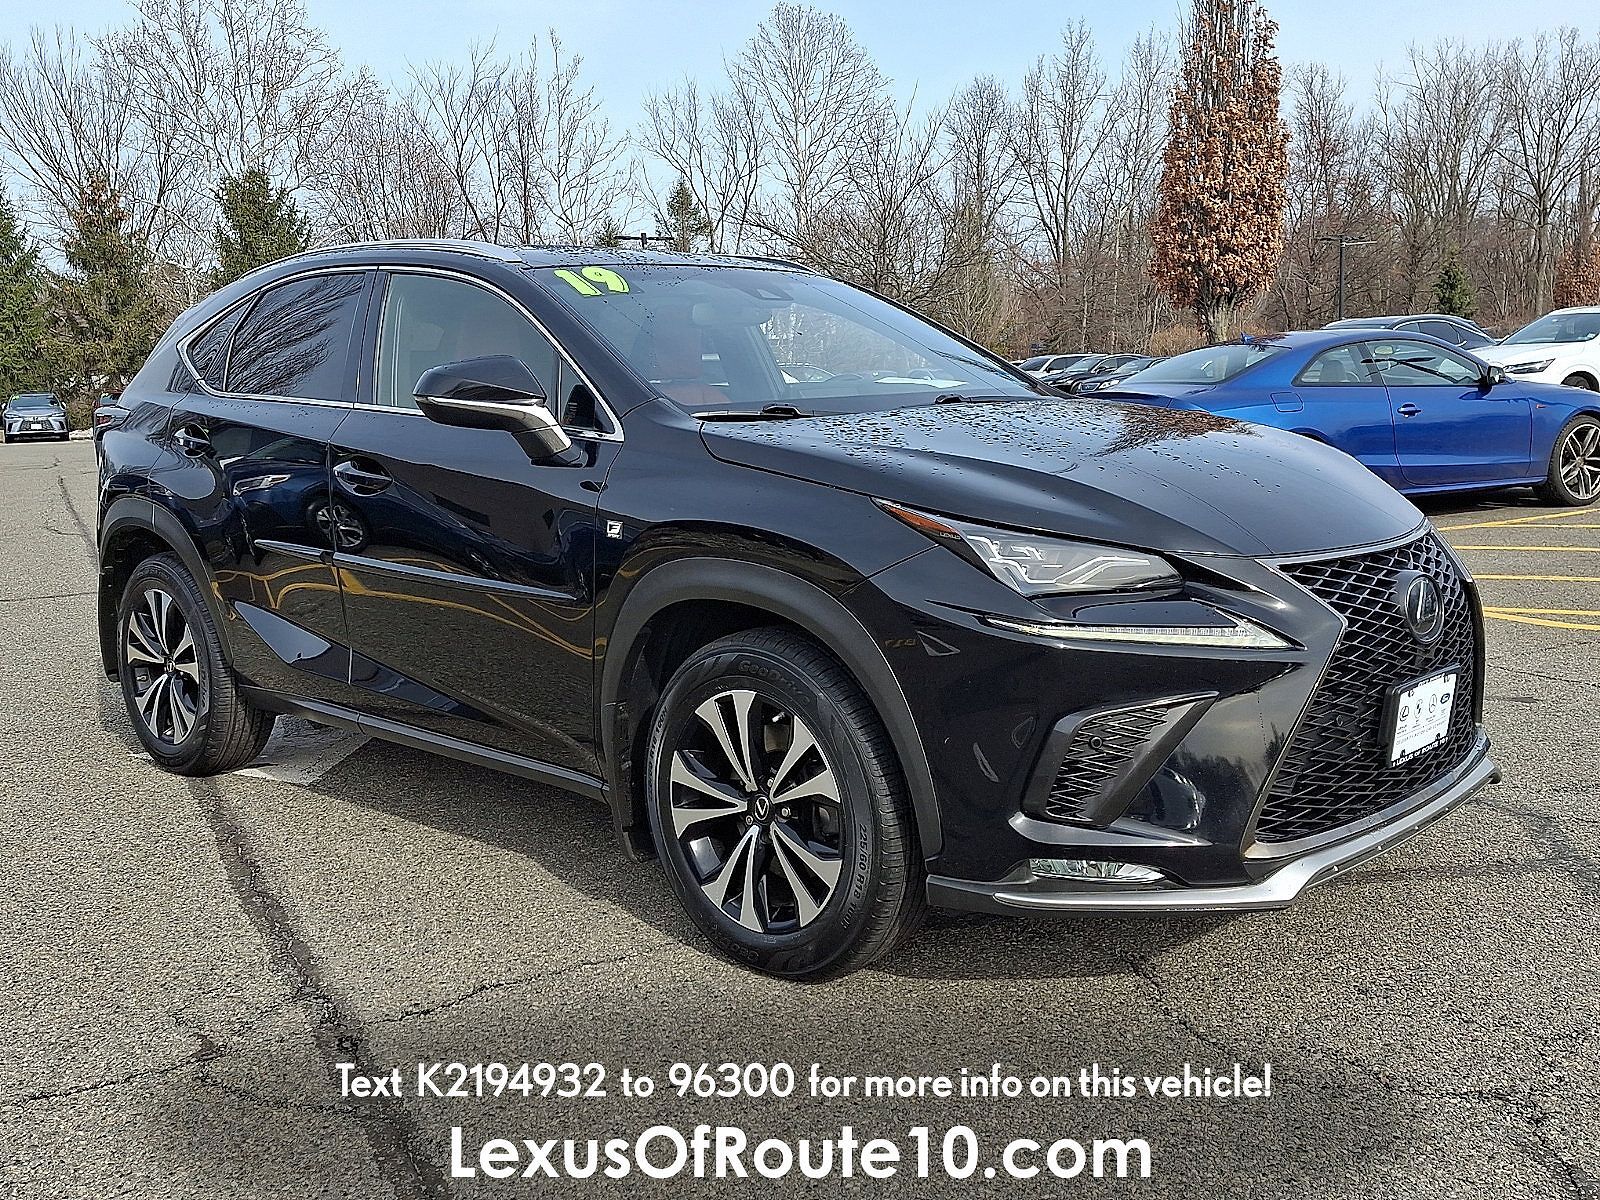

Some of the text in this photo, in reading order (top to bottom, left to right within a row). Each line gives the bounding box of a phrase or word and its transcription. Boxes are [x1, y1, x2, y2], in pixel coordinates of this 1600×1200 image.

[553, 266, 631, 298] 19
[858, 823, 868, 871] 225/60
[854, 873, 865, 900] R18
